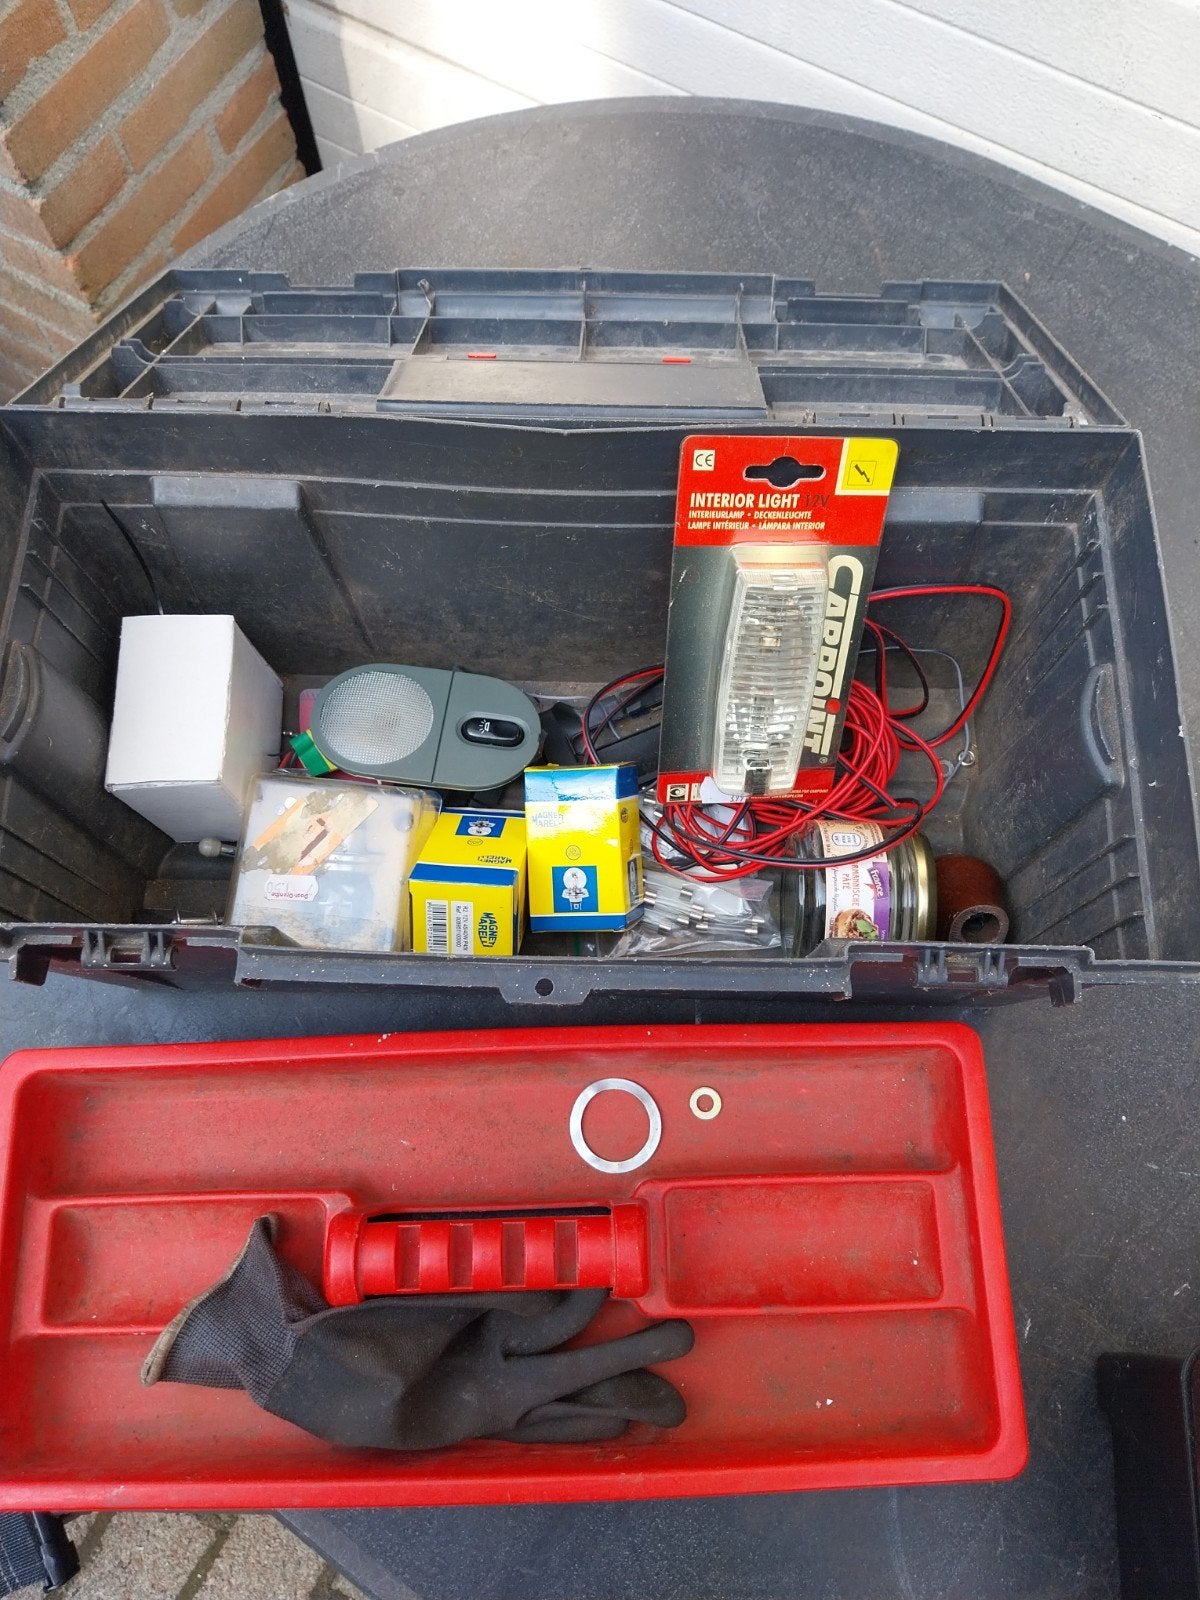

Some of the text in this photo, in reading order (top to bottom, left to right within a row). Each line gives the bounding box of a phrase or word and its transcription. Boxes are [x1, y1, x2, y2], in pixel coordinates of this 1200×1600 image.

[690, 493, 830, 508] INTERIOR LIGHT 12V
[688, 510, 812, 519] INTERIEURLAMP DECKENLEUCHTE
[687, 519, 826, 530] LAMPE INTÉRIEUR LÁMPARA INTERIOR
[852, 863, 860, 907] RMANNISCHE
